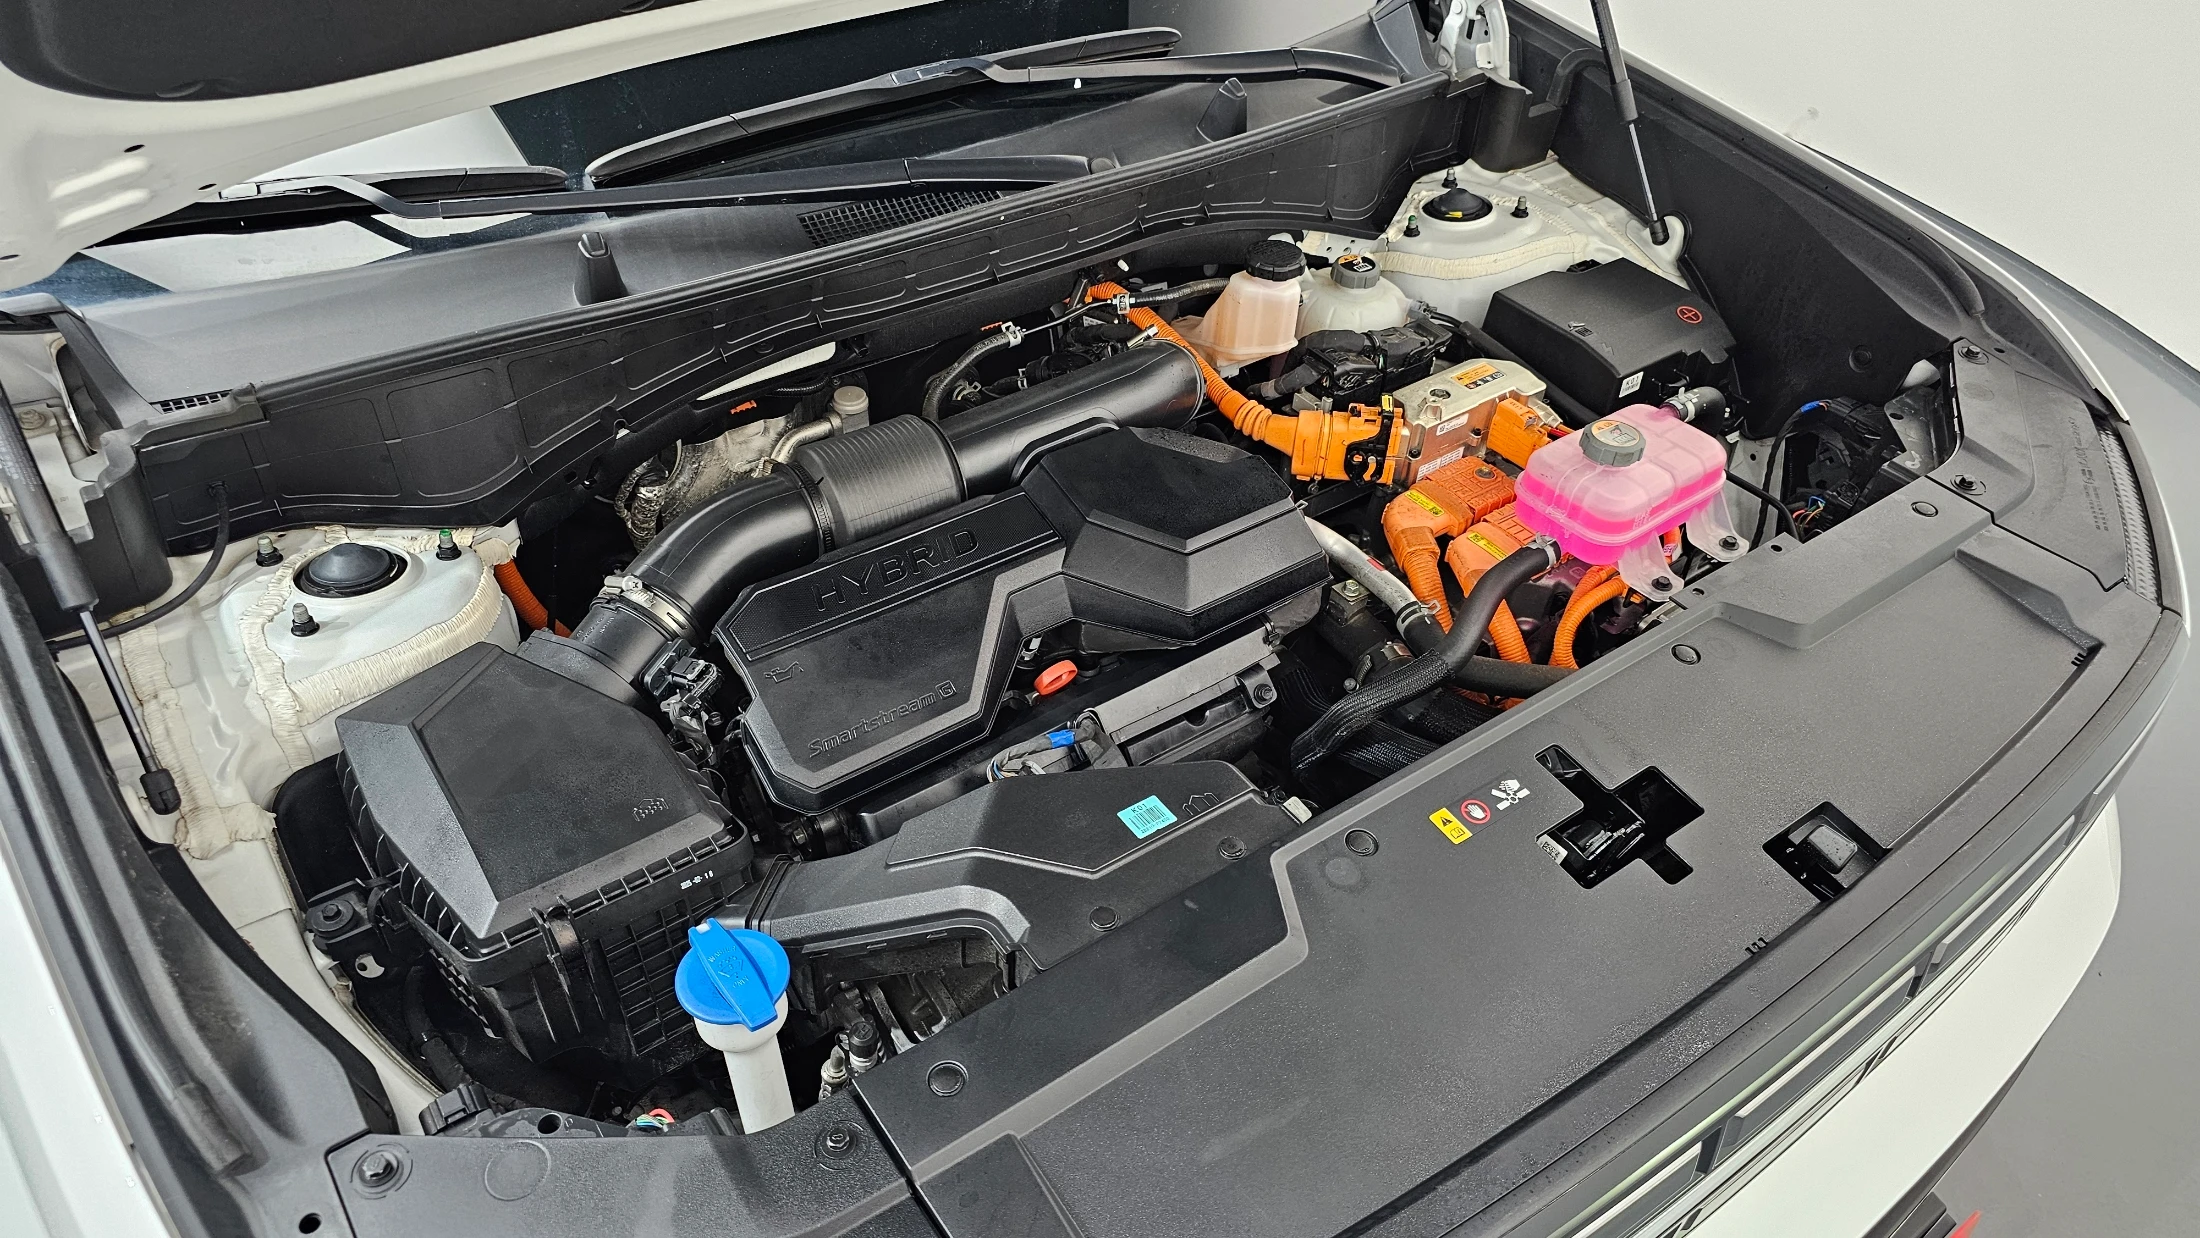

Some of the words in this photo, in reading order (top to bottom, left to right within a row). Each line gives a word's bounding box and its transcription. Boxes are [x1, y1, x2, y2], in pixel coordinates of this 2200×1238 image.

[812, 528, 979, 612] HYBRID
[808, 692, 936, 758] Smartstream
[935, 680, 957, 700] G
[1131, 803, 1148, 814] K01
